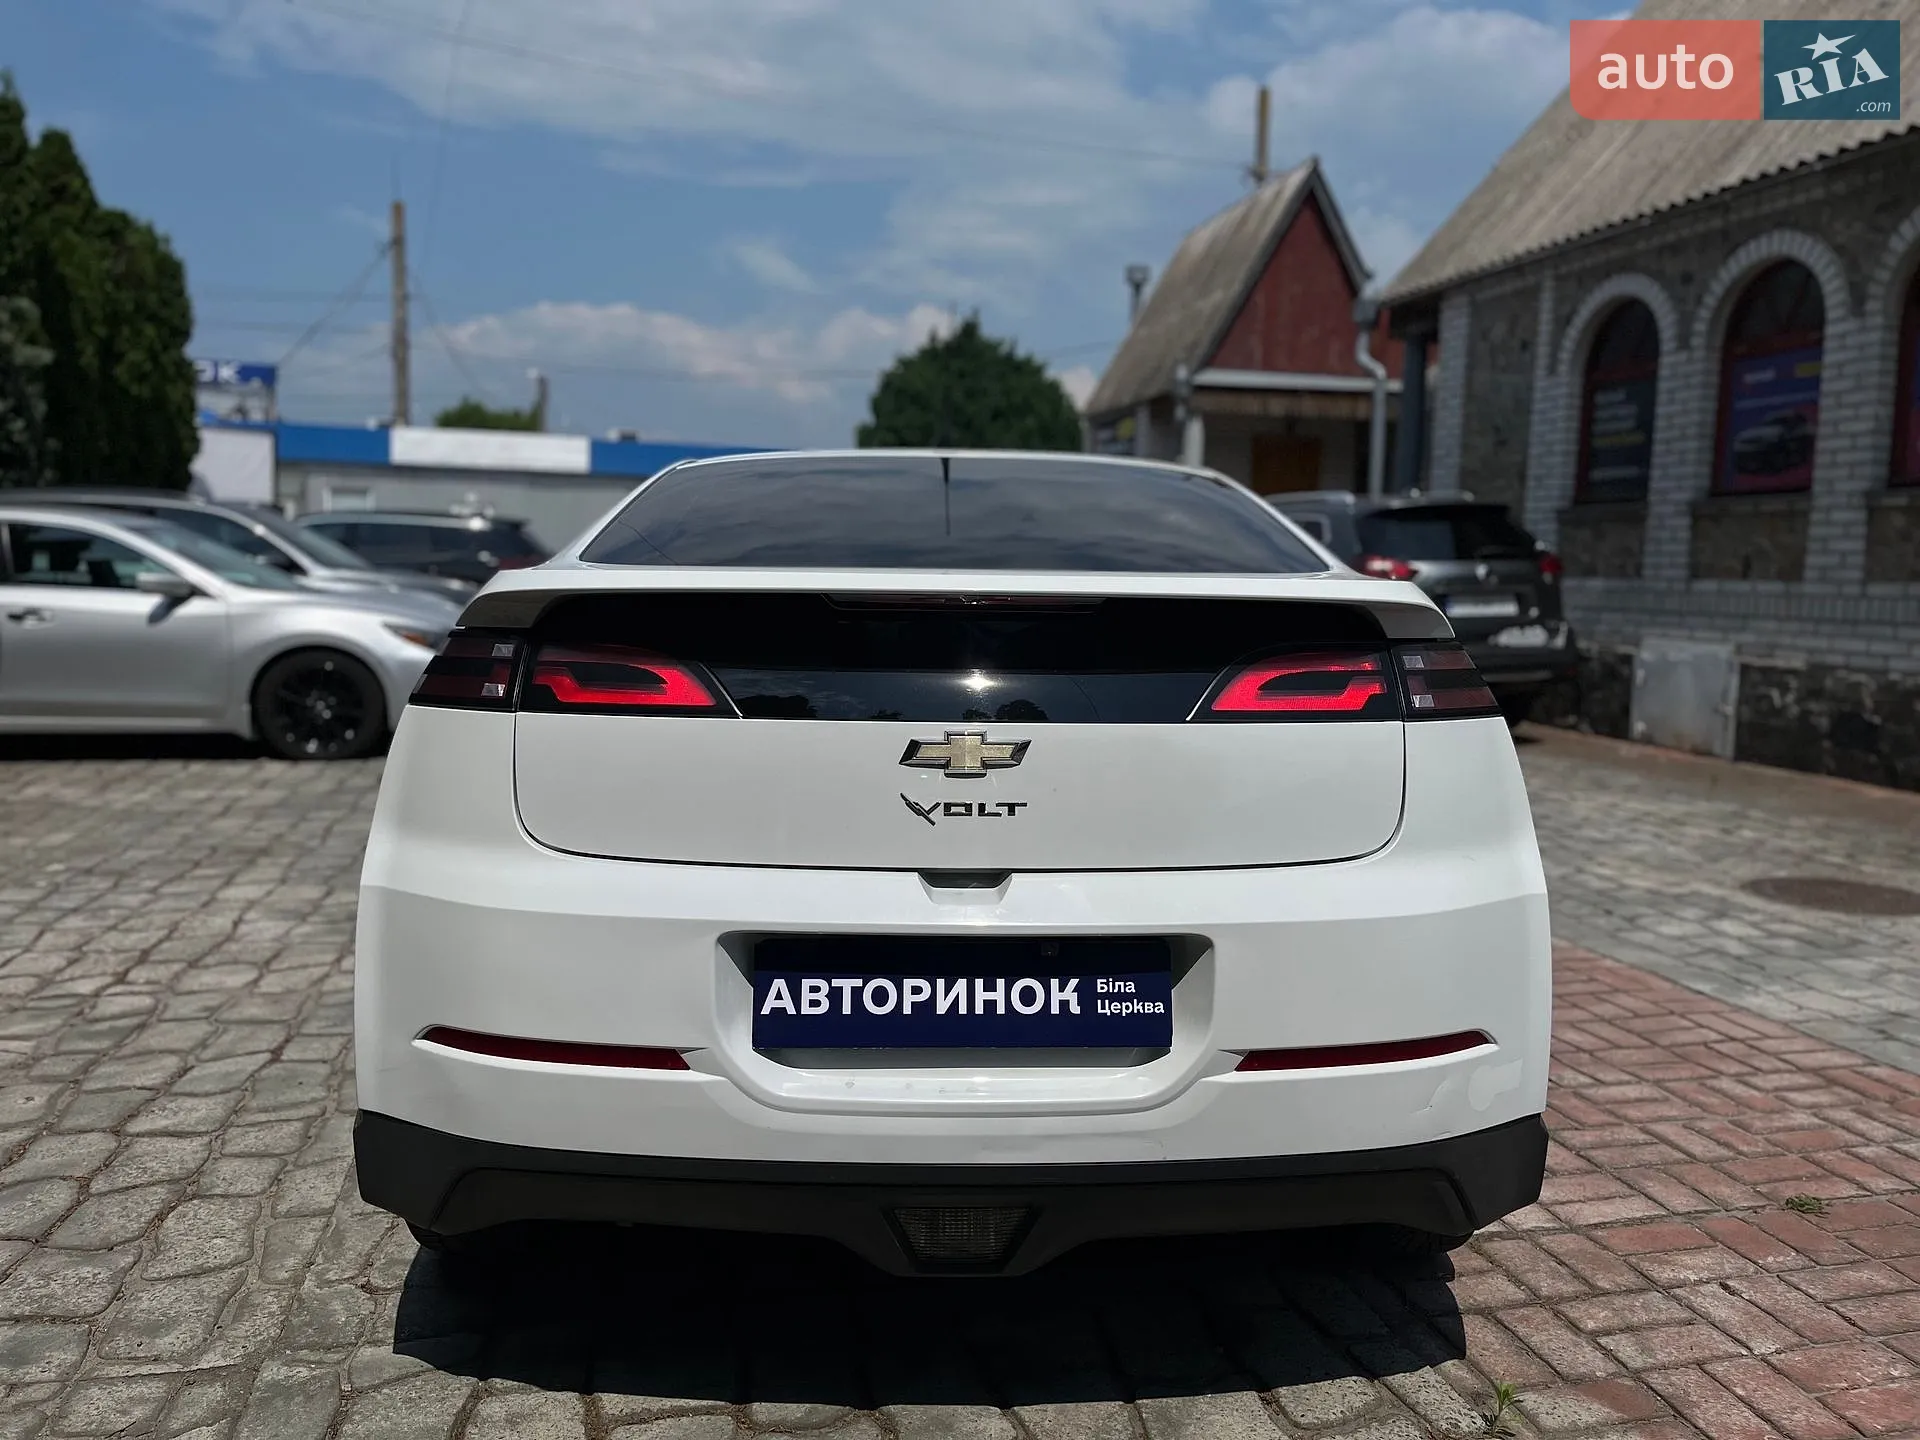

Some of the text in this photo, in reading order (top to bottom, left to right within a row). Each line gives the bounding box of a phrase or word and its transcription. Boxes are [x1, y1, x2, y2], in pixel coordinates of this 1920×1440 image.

[900, 792, 1028, 827] VOLT
[760, 977, 1081, 1016] АВТОРИНОК
[1096, 977, 1136, 993] Біла
[1096, 998, 1165, 1016] Церква
